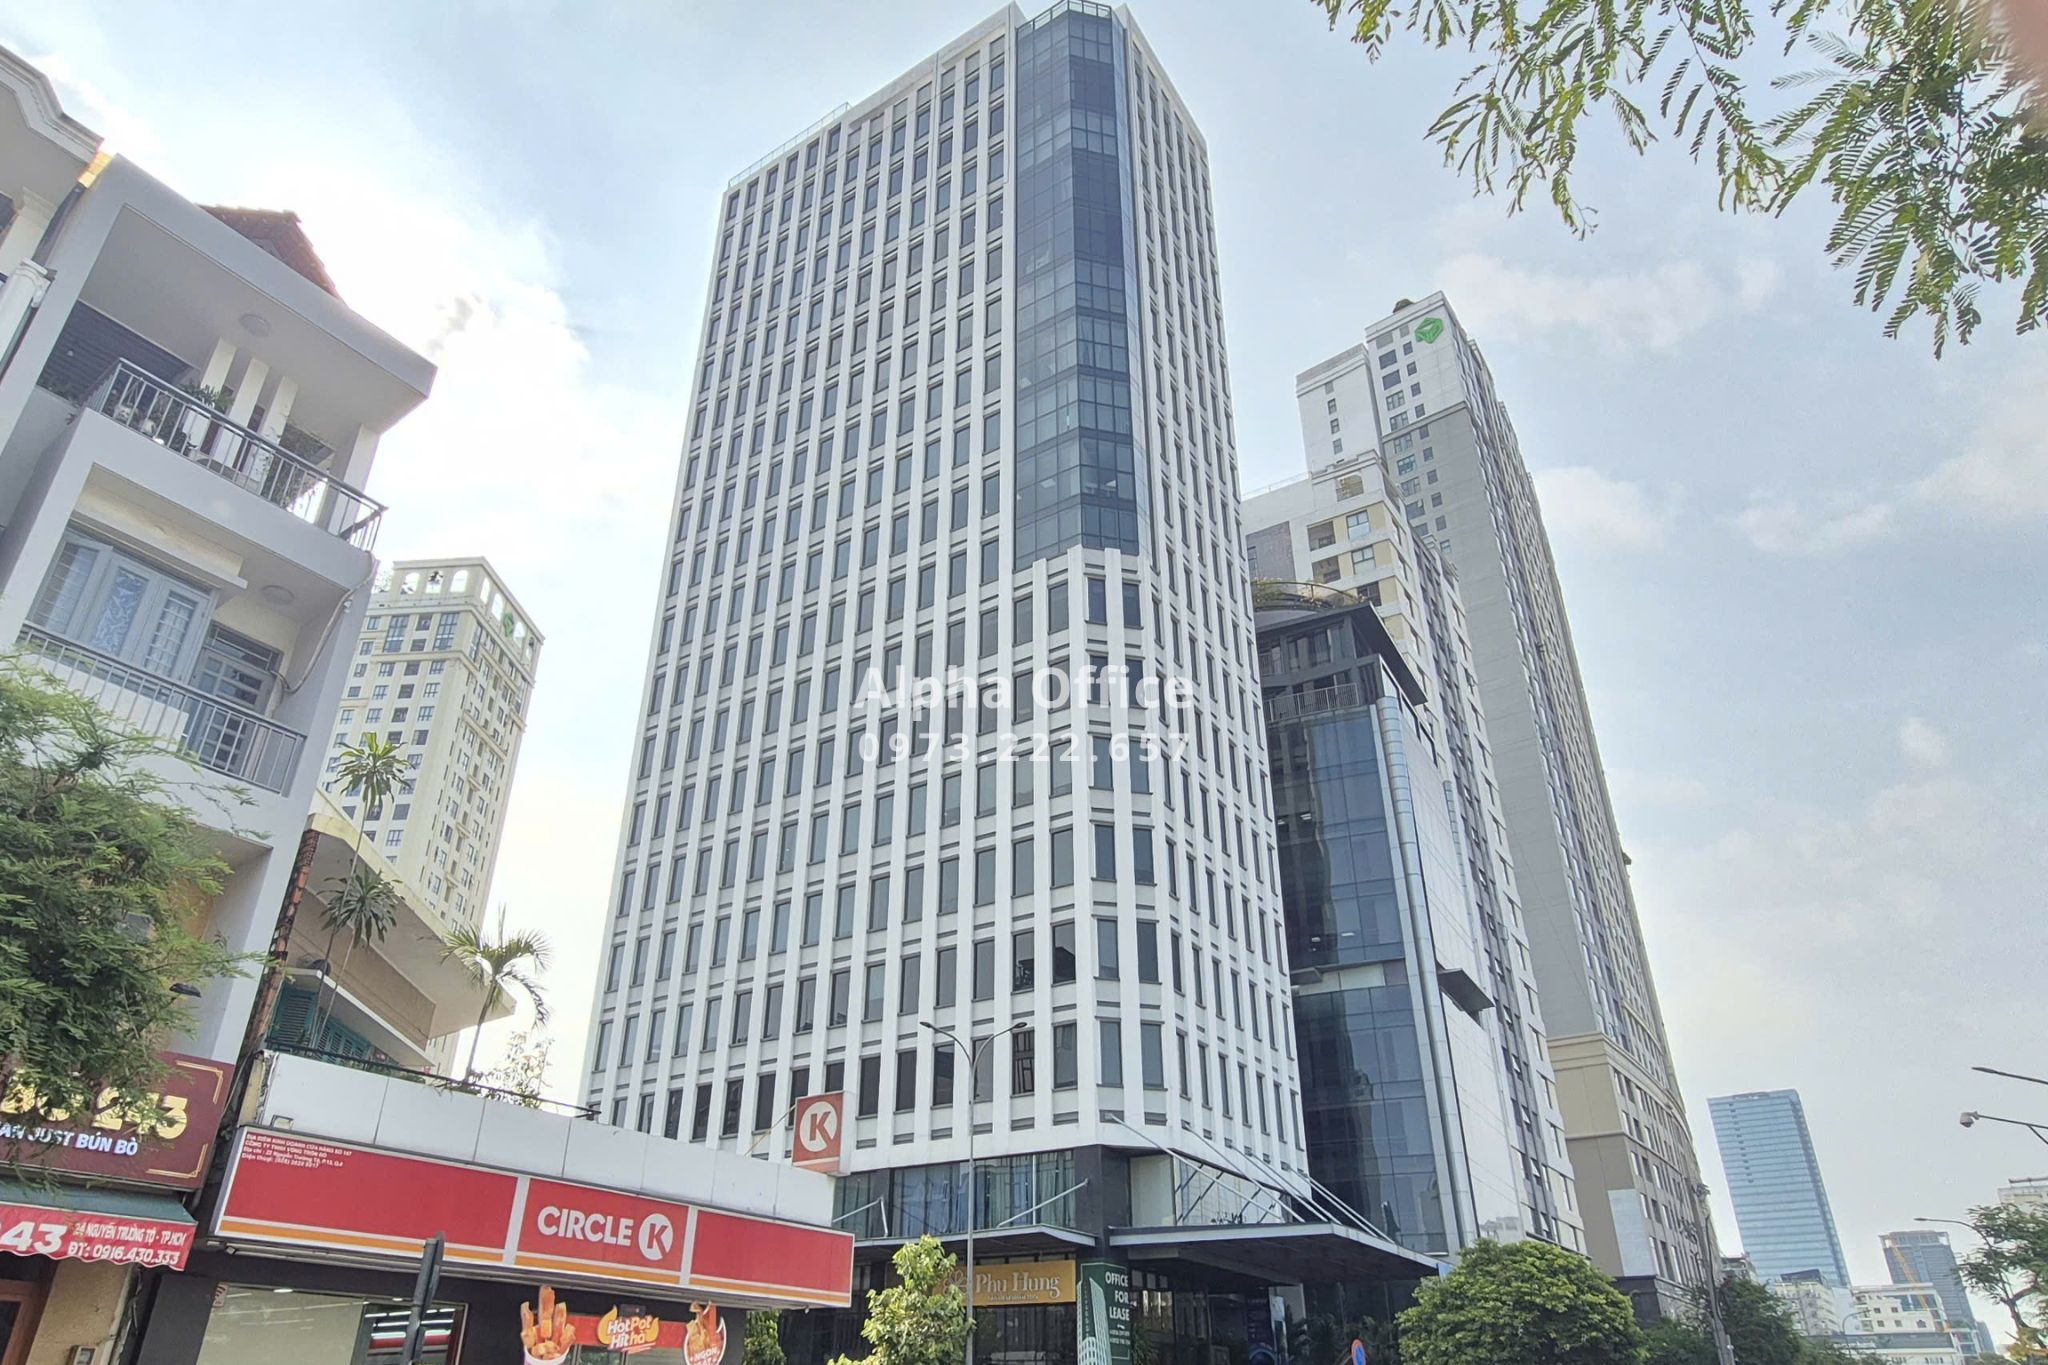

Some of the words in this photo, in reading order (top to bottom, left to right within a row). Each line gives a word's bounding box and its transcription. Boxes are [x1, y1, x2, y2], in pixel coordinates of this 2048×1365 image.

[0, 1121, 26, 1140] AN
[75, 1132, 111, 1153] BÚN
[114, 1136, 138, 1156] BÒ
[804, 1106, 836, 1149] K
[0, 1221, 68, 1253] 43
[537, 1206, 634, 1247] CIRCLE
[643, 1218, 671, 1259] K
[1012, 1271, 1061, 1299] Hung
[1105, 1271, 1129, 1287] OFFICE
[1114, 1290, 1129, 1304] FOR
[1109, 1306, 1130, 1321] LEASE
